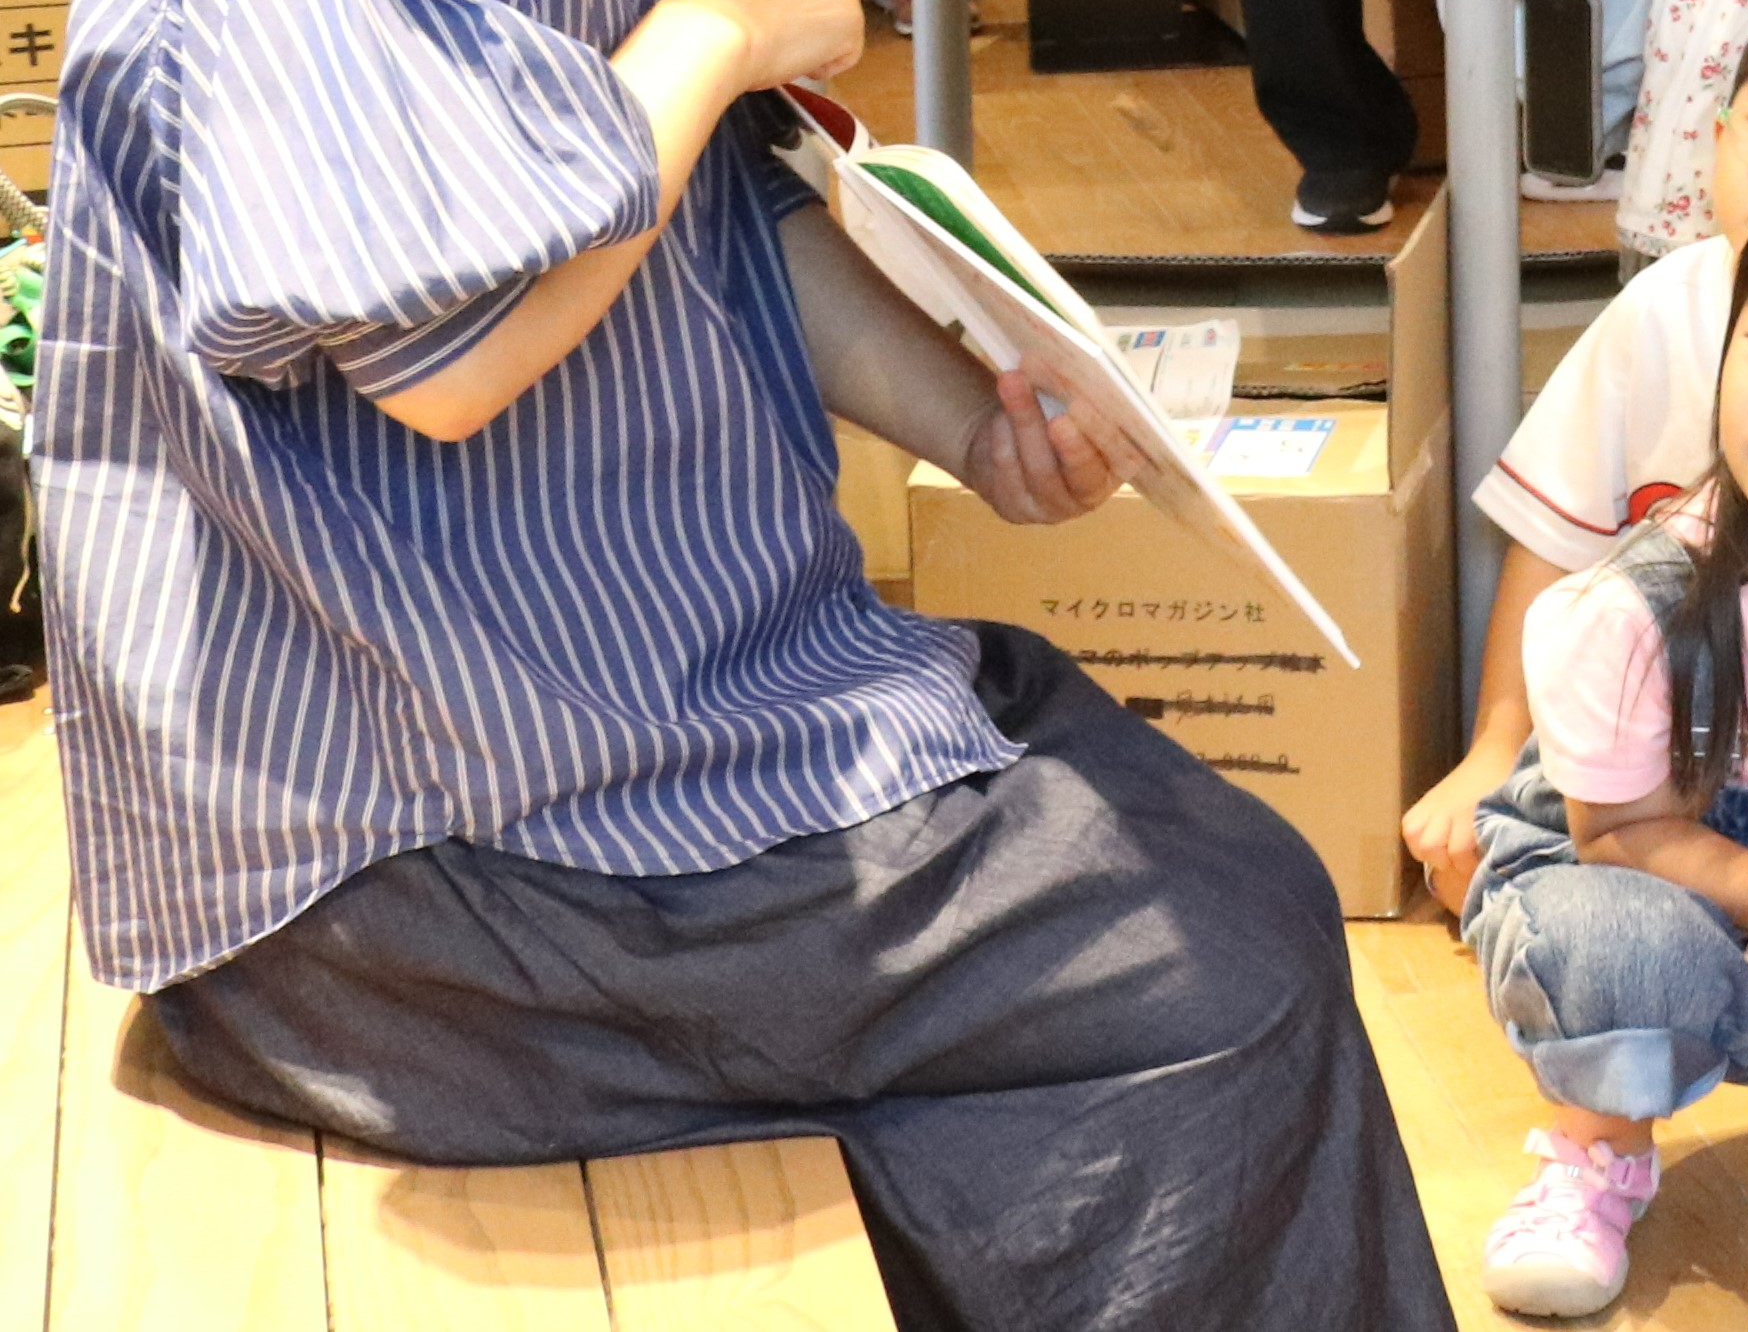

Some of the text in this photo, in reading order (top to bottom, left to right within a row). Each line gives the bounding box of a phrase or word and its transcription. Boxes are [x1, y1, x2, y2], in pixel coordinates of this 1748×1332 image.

[1040, 597, 1266, 624] マイクロマガジン社
